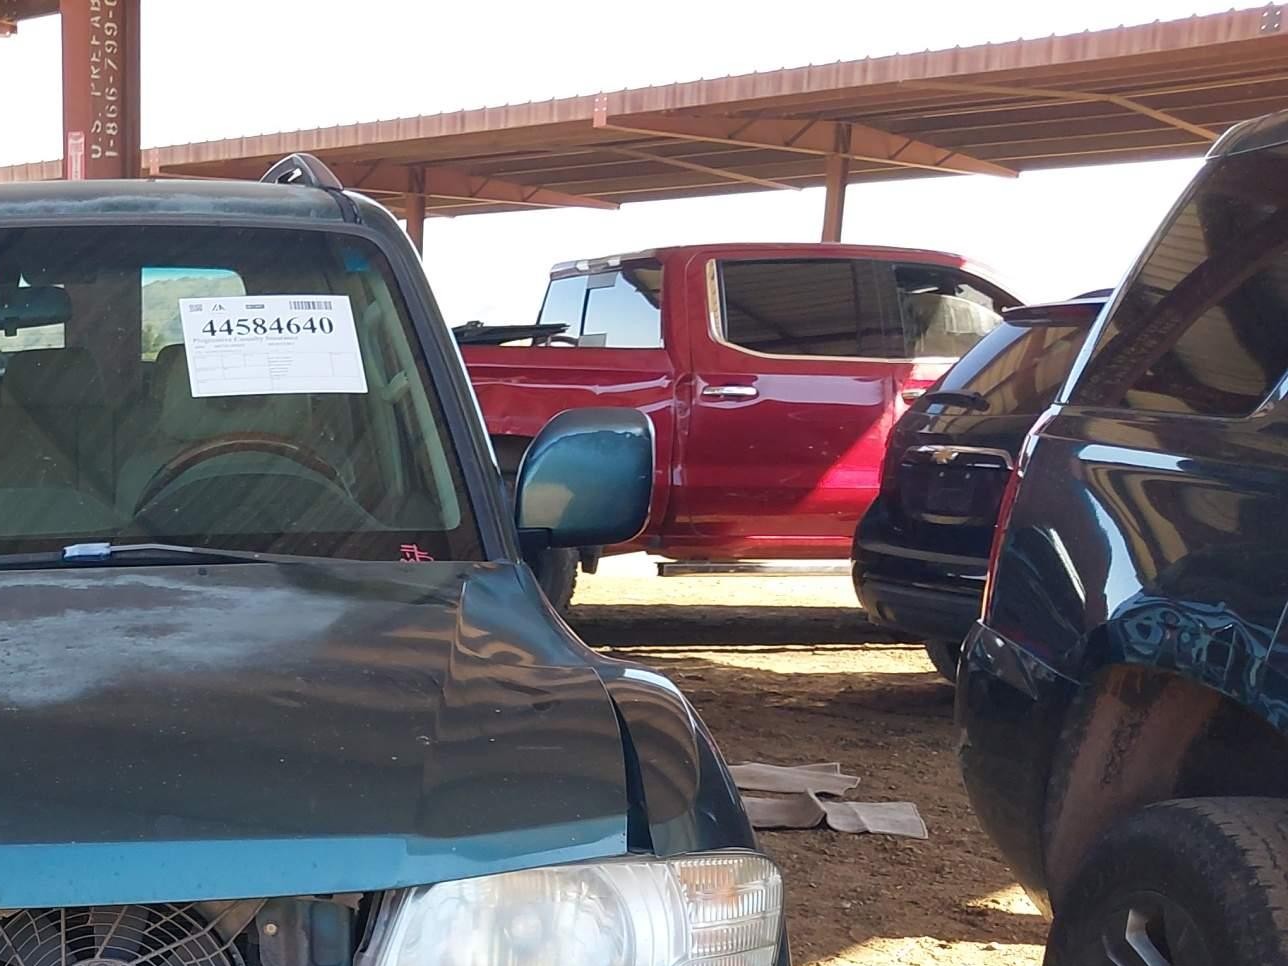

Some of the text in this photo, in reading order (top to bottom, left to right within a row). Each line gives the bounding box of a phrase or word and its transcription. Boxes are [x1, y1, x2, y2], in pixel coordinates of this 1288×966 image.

[90, 0, 102, 159] U.S. PREFAB
[202, 316, 334, 336] 44584640
